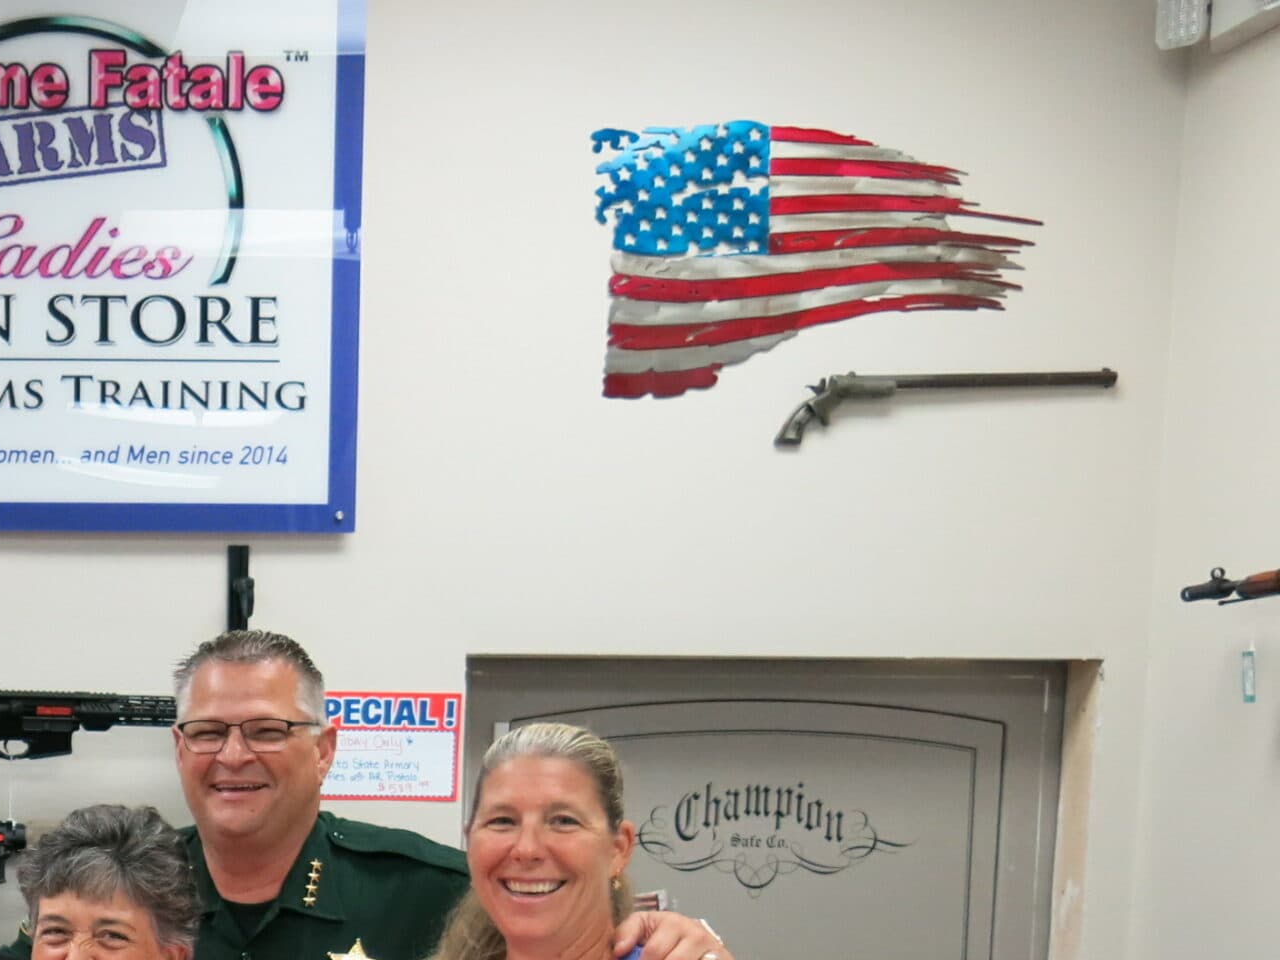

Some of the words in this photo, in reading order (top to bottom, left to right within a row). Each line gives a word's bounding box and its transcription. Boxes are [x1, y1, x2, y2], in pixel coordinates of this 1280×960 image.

[88, 49, 284, 111] Fatale
[45, 294, 279, 348] STORE
[61, 375, 306, 413] TRAINING
[80, 445, 120, 464] and
[126, 445, 170, 464] Men
[178, 445, 233, 464] since
[239, 446, 288, 465] 2014
[674, 781, 844, 842] Champion
[730, 833, 763, 849] Safe
[766, 832, 789, 849] Co.
